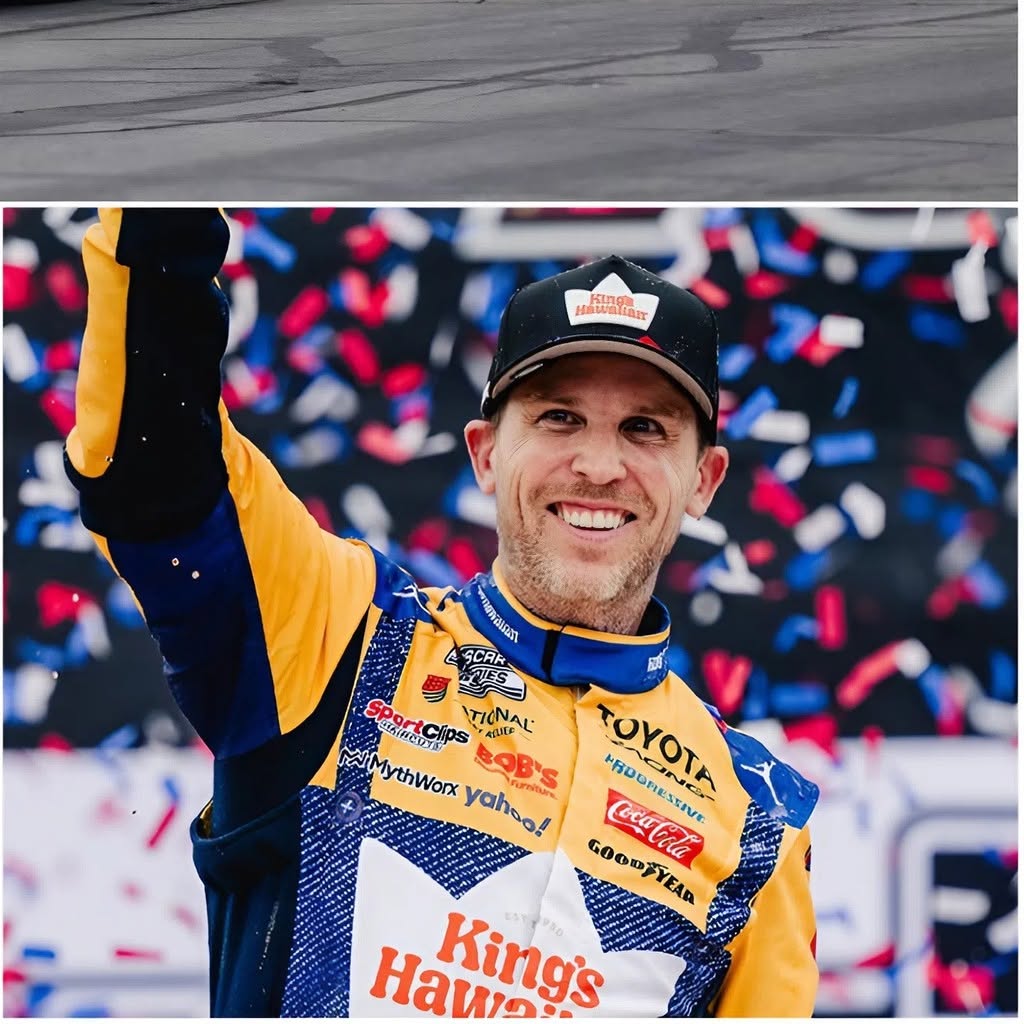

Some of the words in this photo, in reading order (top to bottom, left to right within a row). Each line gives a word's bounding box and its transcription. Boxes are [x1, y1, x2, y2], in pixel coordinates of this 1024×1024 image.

[370, 752, 460, 798] MythWorx
[476, 742, 560, 790] BOB'S
[596, 703, 717, 792] TOYOTA
[464, 785, 553, 838] yahoo!
[587, 838, 695, 906] GOODYEAR
[436, 912, 605, 1009] King's
